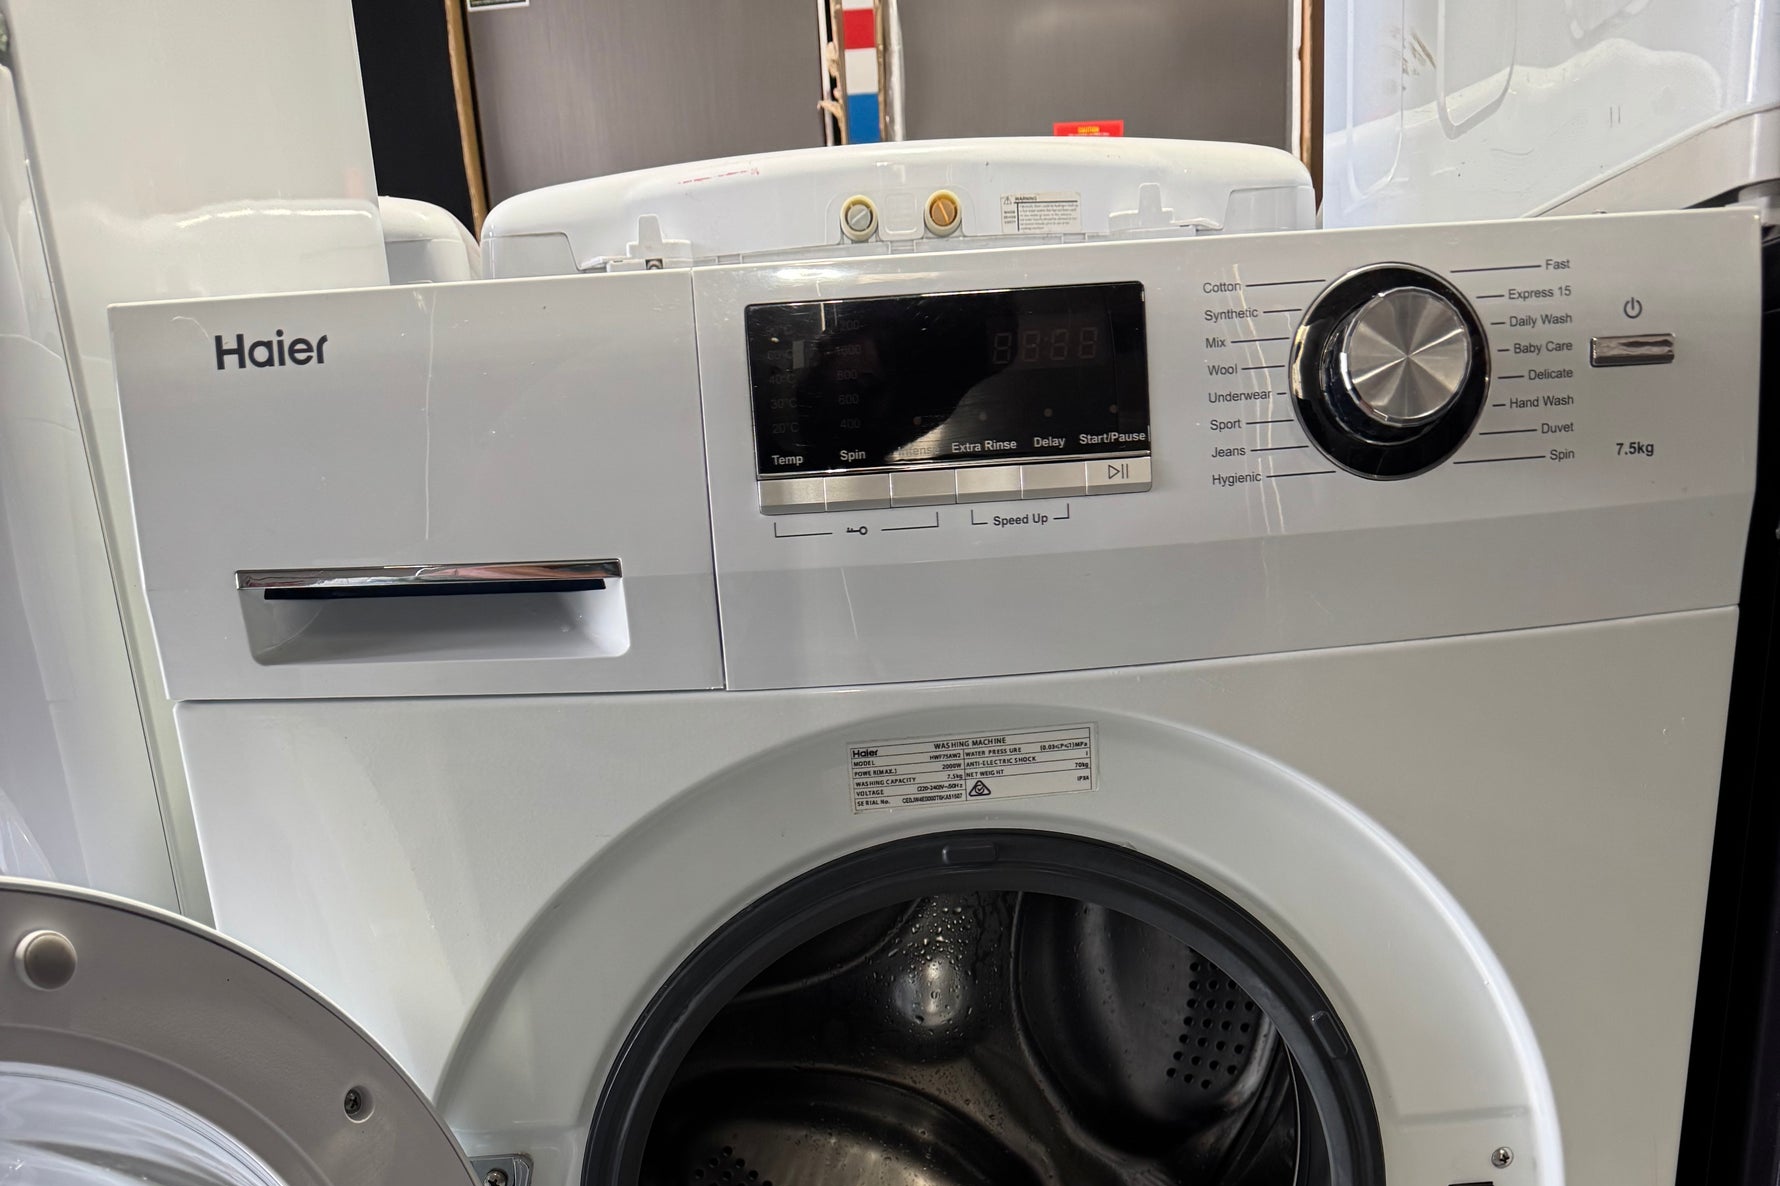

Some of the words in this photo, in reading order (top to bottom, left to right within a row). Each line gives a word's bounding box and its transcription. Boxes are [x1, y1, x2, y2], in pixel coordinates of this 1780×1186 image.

[1546, 259, 1571, 270] Fast
[1203, 282, 1242, 294] Cotton
[1508, 288, 1554, 301] Express
[1558, 286, 1572, 297] 15
[1204, 309, 1259, 323] Synthetic
[1509, 316, 1537, 328] Daily
[1541, 313, 1573, 325] Wash
[214, 328, 328, 370] Haier
[1205, 337, 1227, 349] Mix
[1514, 343, 1542, 356] Baby
[1546, 341, 1573, 352] Care
[1207, 364, 1238, 376] Wool
[1528, 369, 1574, 380] Delicate
[1208, 391, 1272, 403] Underwear
[1509, 398, 1539, 409] Hand
[1542, 395, 1574, 406] Wash
[1210, 419, 1242, 432] Sport
[1541, 422, 1574, 434] Duvet
[1034, 436, 1066, 448] Delay
[1079, 432, 1146, 444] Start/Pause
[952, 442, 981, 453] Extra
[985, 440, 1017, 451] Rinse
[1211, 447, 1246, 458] Jeans
[1616, 441, 1655, 456] 7.5kg
[772, 455, 804, 466] Temp
[840, 450, 866, 461] Spin
[1550, 448, 1575, 462] Spin
[1212, 472, 1262, 487] Hygienic
[993, 514, 1029, 527] Speed
[1033, 513, 1048, 525] Up
[934, 741, 970, 750] WASHING
[971, 737, 1006, 746] MACHINE
[852, 749, 879, 758] Haier
[965, 748, 986, 757] WATER
[1014, 756, 1037, 764] SHOCK
[979, 769, 1004, 777] WEIGHT
[855, 780, 884, 788] WASHING
[885, 777, 916, 785] CAPACITY
[856, 789, 884, 797] VOLTAGE
